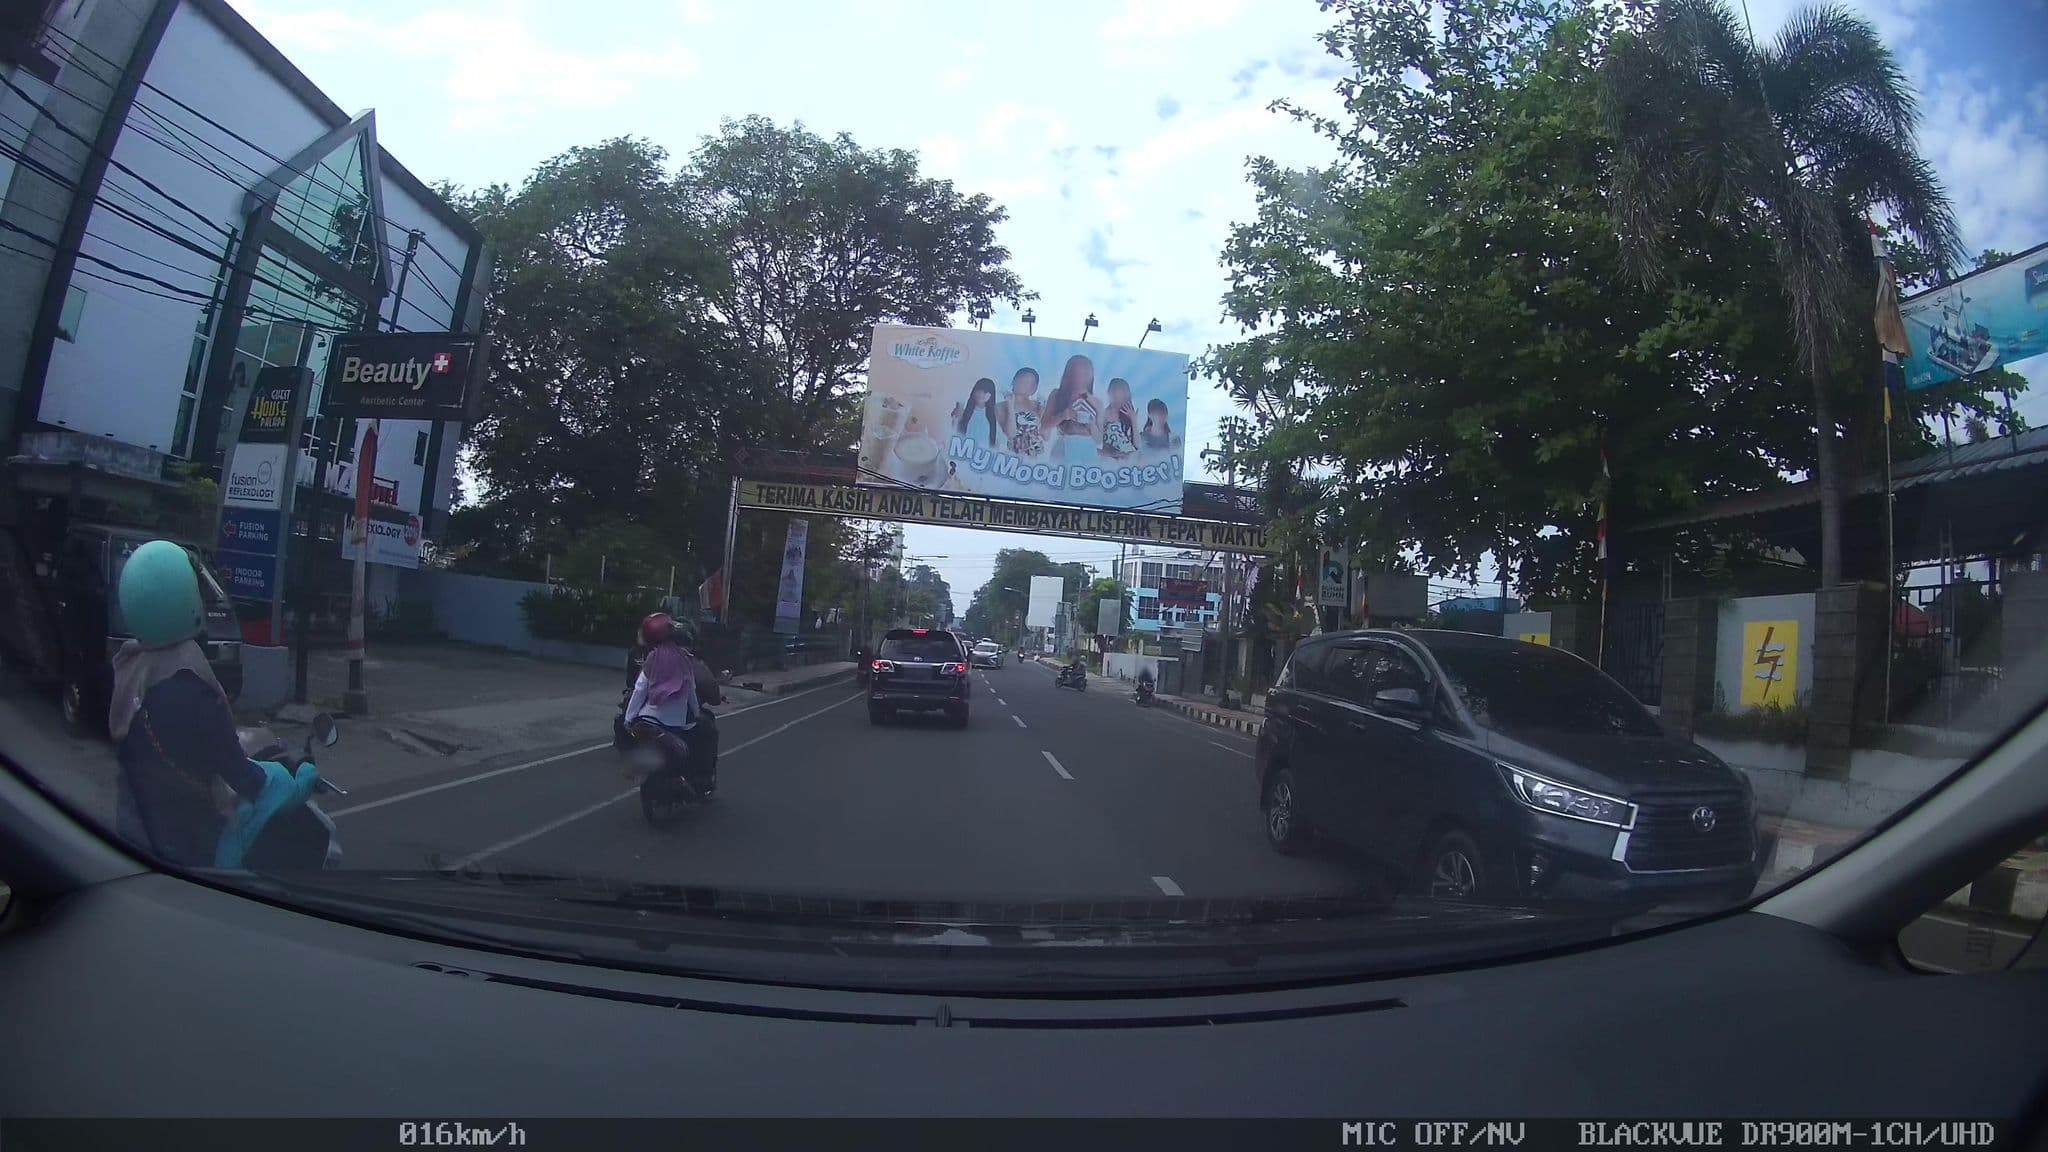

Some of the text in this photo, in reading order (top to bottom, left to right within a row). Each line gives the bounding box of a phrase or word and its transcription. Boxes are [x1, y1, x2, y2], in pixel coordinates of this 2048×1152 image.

[894, 344, 960, 361] White Koffie
[342, 356, 431, 390] Beauty
[399, 396, 425, 406] Center
[950, 436, 992, 470] My
[993, 453, 1064, 488] Mood
[231, 472, 258, 486] fusion
[756, 484, 1267, 548] TERIMA KASIH ANDA TELAH MEMBAYAR LISTRIK TEPAT WAKTU
[240, 521, 265, 531] FUSION
[239, 531, 269, 541] PARKING
[235, 567, 263, 577] INDOOR
[234, 576, 265, 587] PARKING
